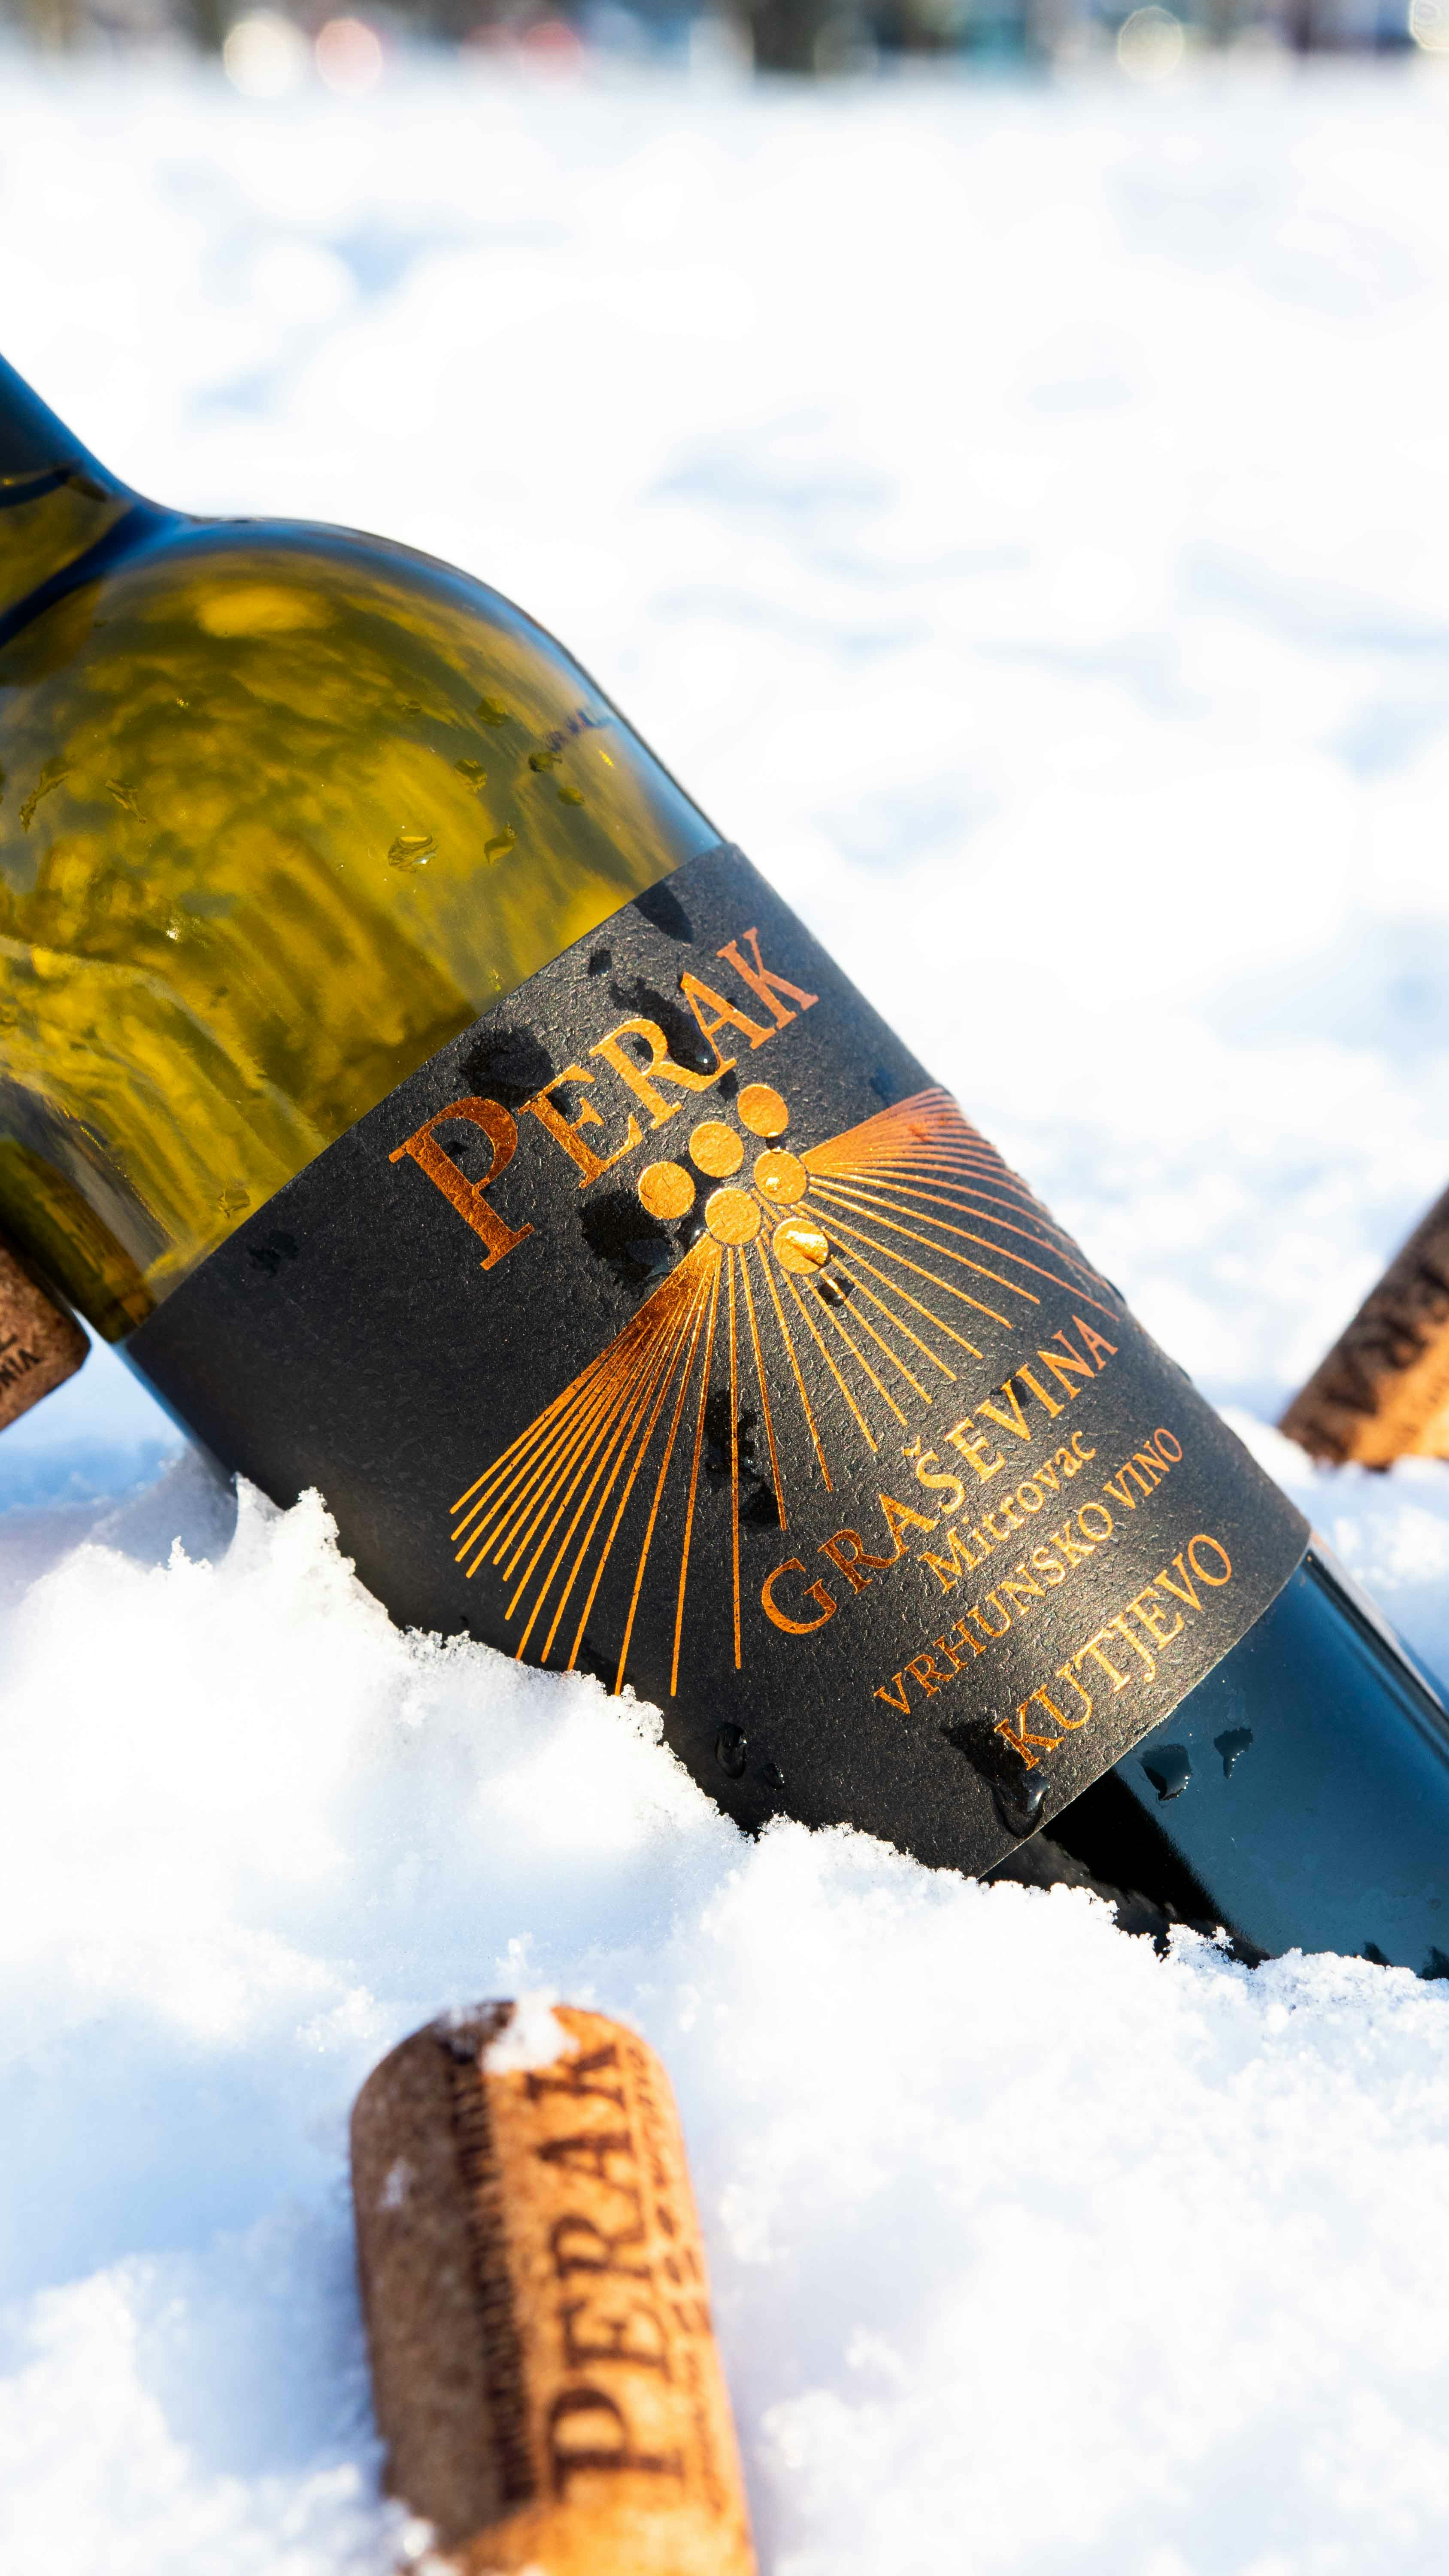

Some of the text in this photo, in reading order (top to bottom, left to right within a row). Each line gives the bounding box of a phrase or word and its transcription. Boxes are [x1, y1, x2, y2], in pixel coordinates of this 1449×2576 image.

[389, 927, 819, 1271] PERAK
[761, 1315, 1118, 1635] GRAŠEVINA
[873, 1427, 1183, 1715] VRHUNSKO VINO
[917, 1431, 1096, 1594] Mitrovac
[994, 1534, 1232, 1771] KUTJEVO
